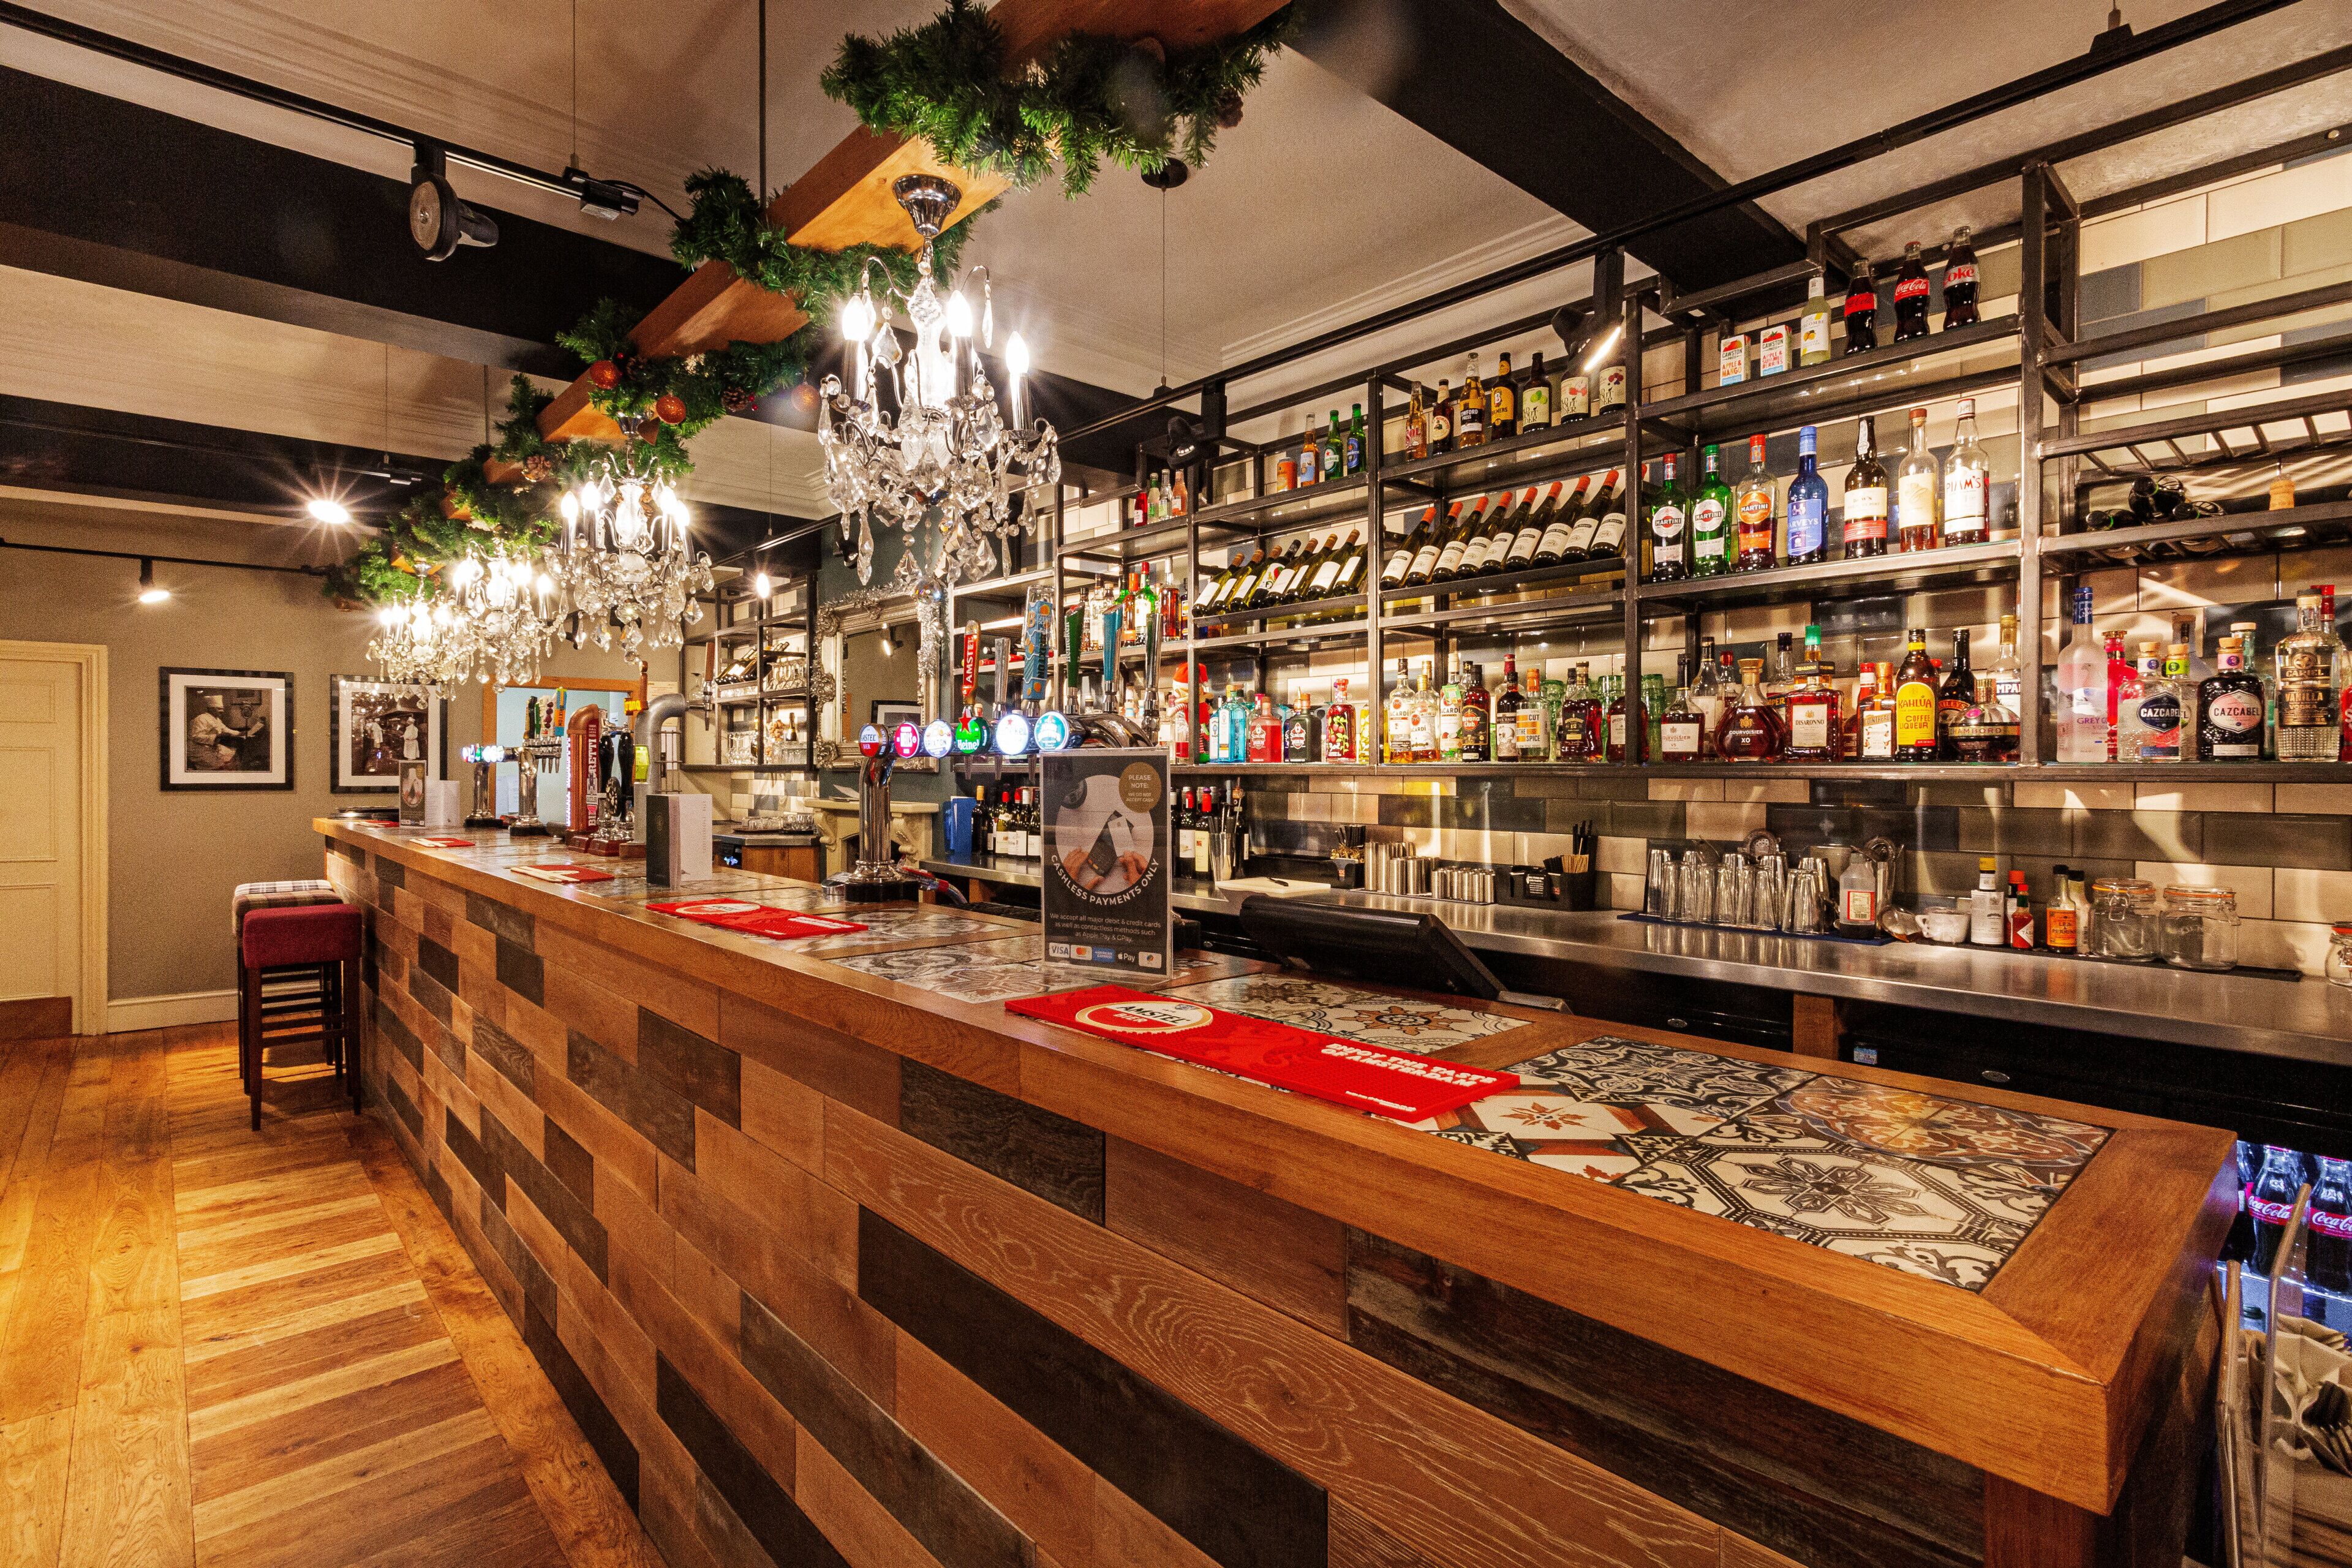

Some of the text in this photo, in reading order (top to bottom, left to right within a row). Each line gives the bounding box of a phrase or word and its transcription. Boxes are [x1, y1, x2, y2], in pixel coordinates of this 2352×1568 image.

[1762, 339, 1784, 349] CAWSTON
[1722, 349, 1743, 358] CAWSTON
[1722, 367, 1741, 377] MANGO
[1741, 503, 1769, 513] MARTINI
[1695, 511, 1722, 521] MARTINI
[1655, 518, 1682, 526] MARTINI
[965, 636, 974, 684] AMSTEL
[1898, 695, 1932, 709] KAHLÚA
[2285, 692, 2323, 702] VANILLA
[2214, 707, 2260, 717] CAZCABEL
[1051, 854, 1159, 905] CASHLESS PAYMENTS ONLY
[1081, 923, 1114, 932] contactless
[1114, 926, 1140, 935] methods
[1082, 931, 1098, 940] Apple
[1100, 932, 1111, 941] Pay
[1052, 945, 1069, 956] VISA
[1123, 953, 1135, 962] Pay
[1113, 1012, 1148, 1023] BIER
[1117, 1005, 1188, 1024] AMSTEL
[1321, 1048, 1478, 1088] OF AMSTERDAM
[1325, 1043, 1498, 1084] ENJOY THE TASTE
